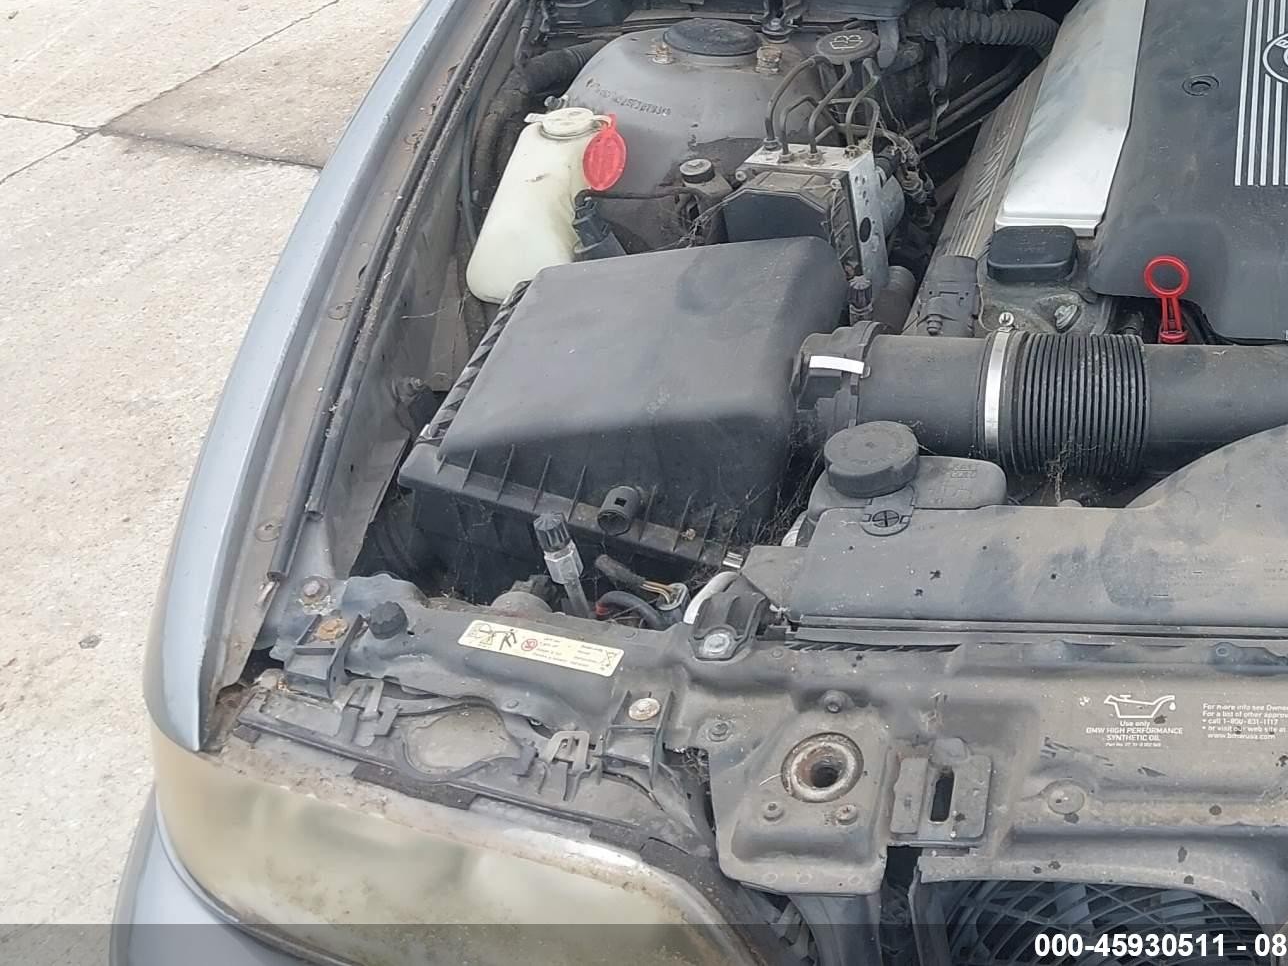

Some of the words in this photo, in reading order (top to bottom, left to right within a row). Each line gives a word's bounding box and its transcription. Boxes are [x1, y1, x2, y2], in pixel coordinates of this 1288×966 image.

[1202, 702, 1215, 710] For
[1135, 720, 1151, 729] only
[1126, 727, 1184, 735] PERFORMANCE
